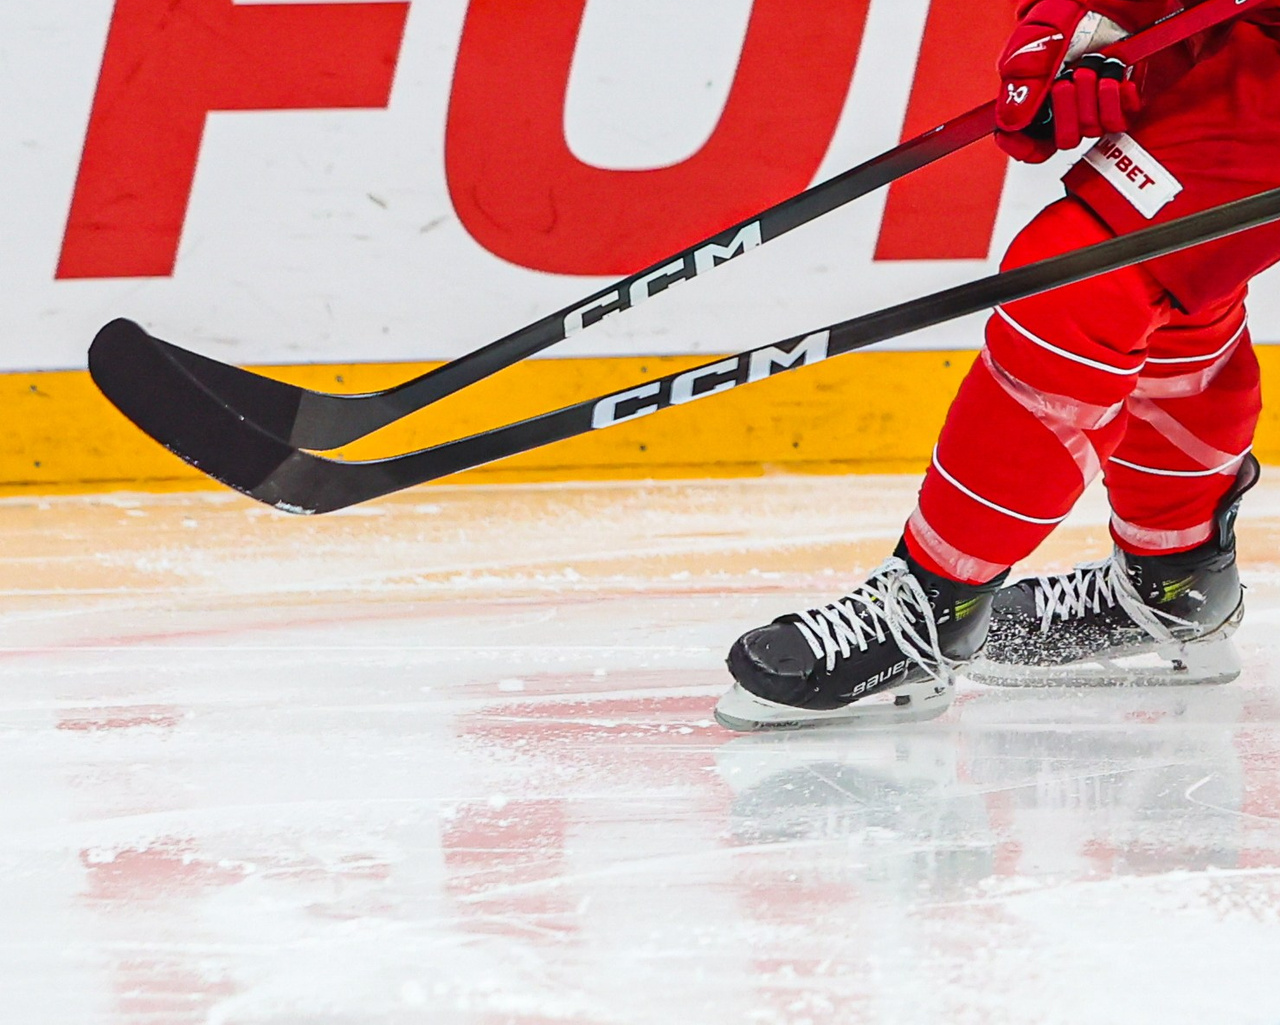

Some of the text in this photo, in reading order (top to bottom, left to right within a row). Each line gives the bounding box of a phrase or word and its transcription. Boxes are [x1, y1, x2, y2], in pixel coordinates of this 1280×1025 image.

[1096, 137, 1157, 191] MPBET
[563, 219, 764, 339] CCM
[590, 330, 831, 430] CCM
